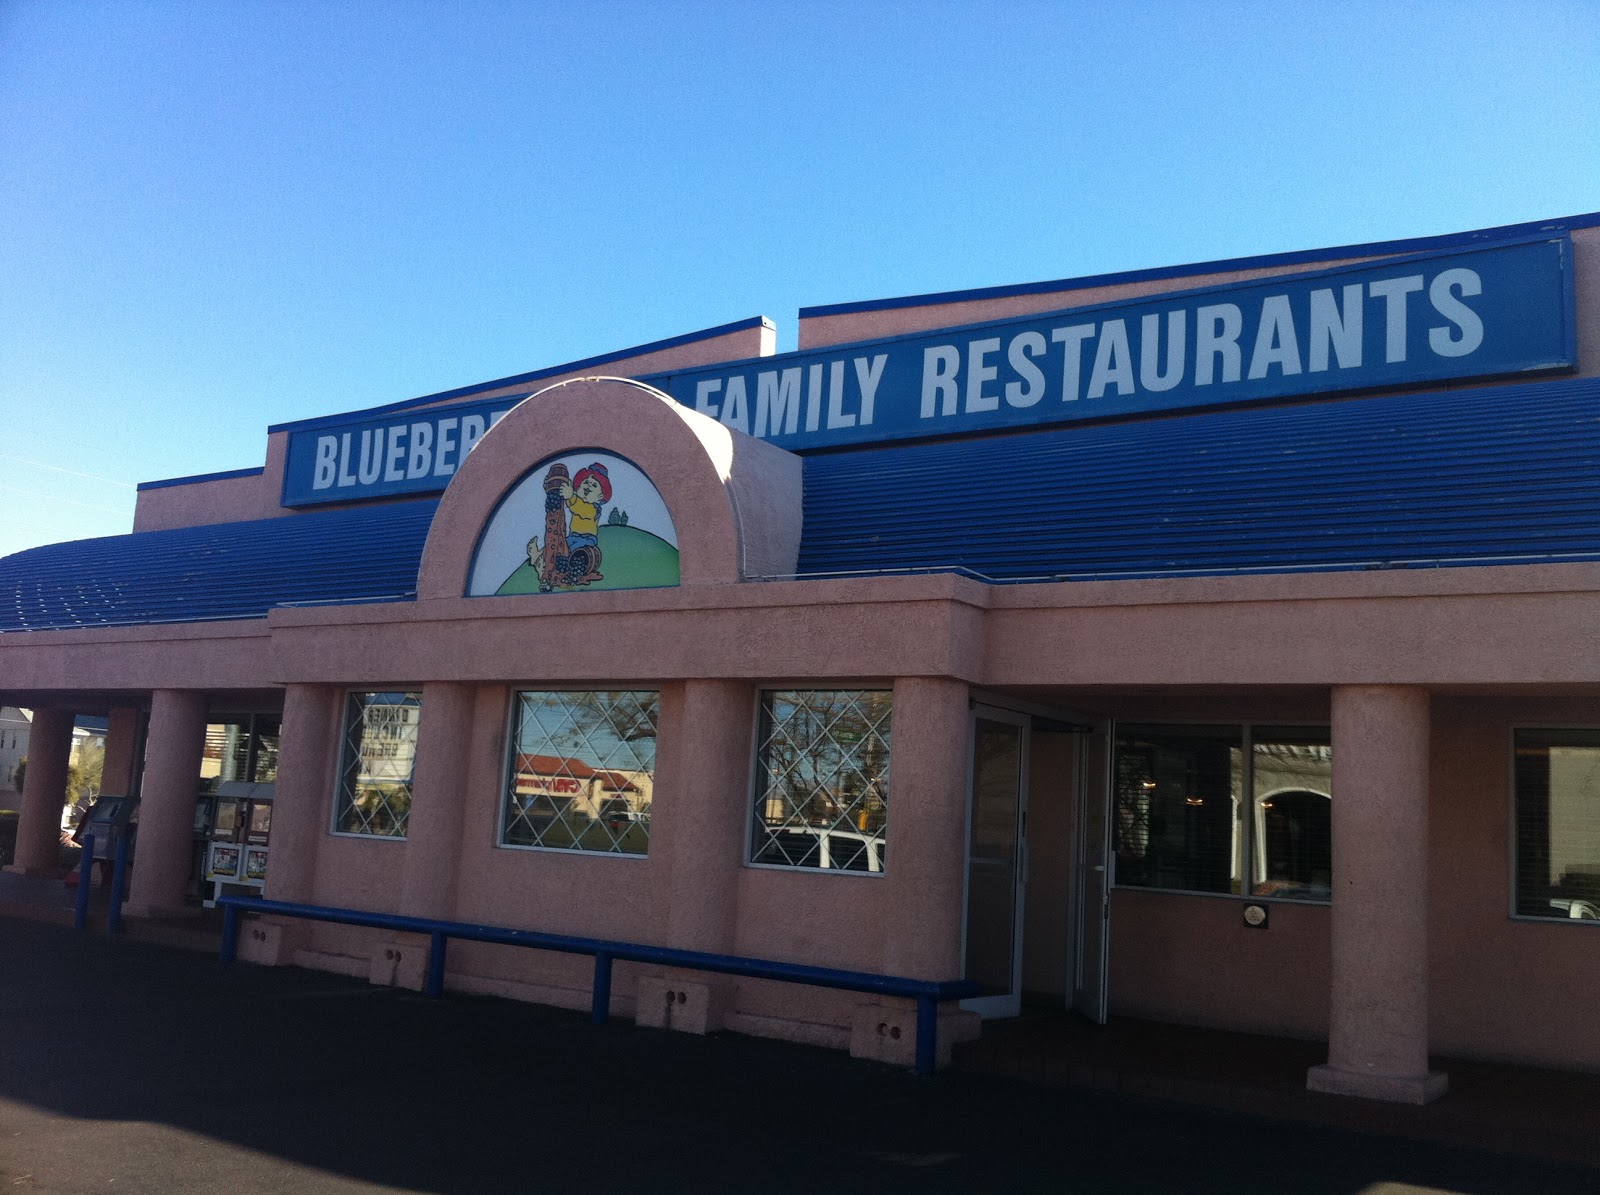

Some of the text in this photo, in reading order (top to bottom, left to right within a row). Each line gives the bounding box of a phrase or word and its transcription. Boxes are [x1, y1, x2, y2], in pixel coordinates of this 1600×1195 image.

[312, 267, 1484, 490] BLUEBER FAMILY RESTAURANTS
